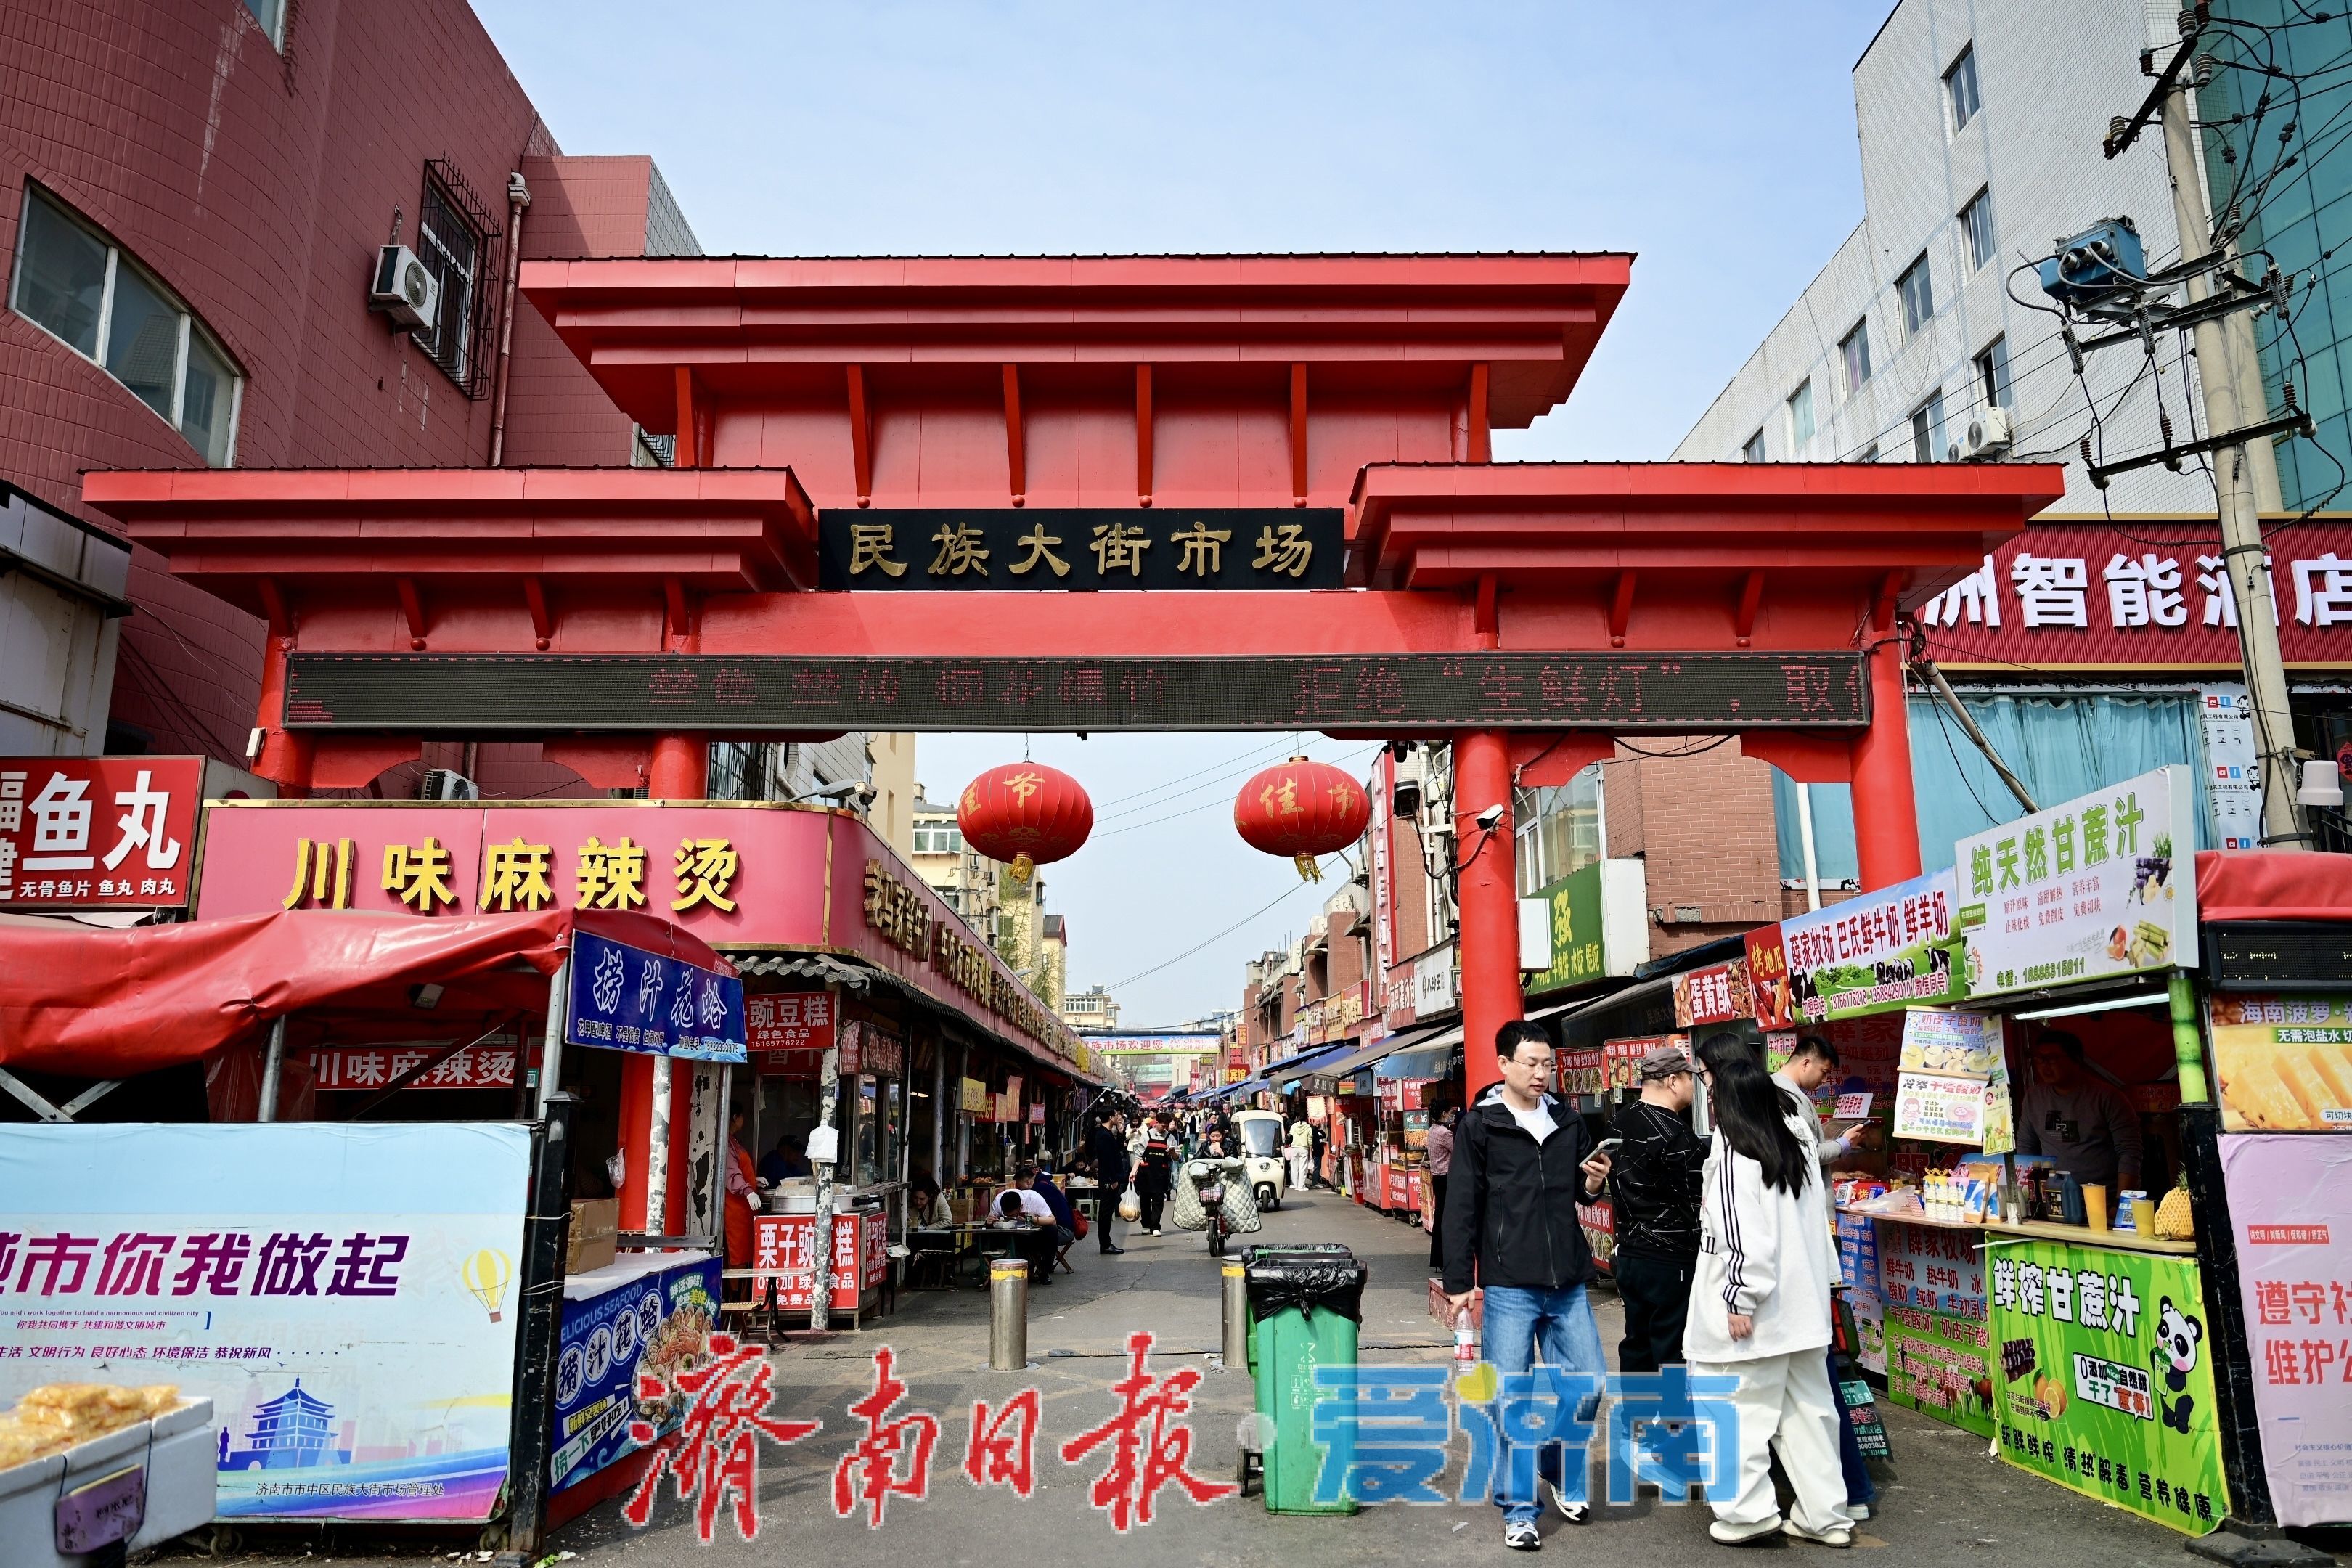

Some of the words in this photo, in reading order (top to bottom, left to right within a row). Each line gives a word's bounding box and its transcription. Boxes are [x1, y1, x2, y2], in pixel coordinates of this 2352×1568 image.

[849, 522, 1312, 577] 民族大街市场
[1259, 777, 1357, 819] 佳节
[22, 770, 181, 870] 鱼丸
[1971, 791, 2144, 898] 纯天然甘蔗汁
[20, 881, 91, 898] 无骨鱼片
[98, 881, 134, 897] 鱼丸
[141, 878, 175, 896] 肉丸
[282, 835, 739, 912] 川味麻辣烫
[2004, 896, 2029, 915] 原汁原味
[2072, 875, 2101, 897] 营养丰富
[1789, 926, 1835, 973] 薛家牧场
[1837, 905, 1900, 960] 巴氏鲜牛奶
[1903, 890, 1950, 943] 鲜羊奶
[2005, 914, 2030, 934] 止咳化痰
[2038, 907, 2065, 927] 免费削皮
[2073, 896, 2102, 918] 免费切块
[1751, 942, 1784, 978] 烤地瓜
[592, 947, 727, 1029] 捞汁花蛤
[1690, 977, 1731, 1018] 蛋黄酥
[745, 996, 828, 1028] 豌豆糕
[577, 1018, 612, 1040] 花甲配啤酒
[616, 1026, 640, 1044] 不是很贵
[751, 1040, 805, 1048] 15165776222
[757, 1029, 810, 1039] 绿色食品
[2278, 1029, 2341, 1042] 无需泡盐水
[309, 1050, 514, 1086] 川味麻辣烫
[759, 1220, 854, 1269] 栗子豌糕
[2311, 1230, 2328, 1241] 扬正气
[799, 1273, 854, 1289] 绿食品
[1886, 1257, 1914, 1281] 鲜牛奶
[1926, 1265, 1959, 1290] 热牛奶
[1971, 1274, 1983, 1294] 冰
[562, 1307, 603, 1342] ELICIOUS
[603, 1284, 642, 1319] SEAFOOD
[1887, 1282, 1908, 1303] 酸奶
[1916, 1287, 1937, 1310] 纯奶
[1993, 1257, 2141, 1338] 鲜榨甘蔗汁
[17, 1320, 79, 1330] 你我共同携手
[82, 1320, 167, 1330] 共建和谐文明城市
[1940, 1316, 1990, 1349] 奶皮子酸
[27, 1346, 85, 1358] 文明行为
[91, 1346, 147, 1359] 良好心态
[152, 1346, 209, 1359] 环境保洁
[214, 1347, 271, 1359] 恭祝新风
[2120, 1368, 2147, 1392] 自然甜
[2001, 1424, 2054, 1464] 新鲜鲜榨
[2063, 1446, 2129, 1490] 清热解毒
[256, 1482, 444, 1498] 济南市市中区民族大街市场管理处
[2138, 1472, 2212, 1522] 营养健康
